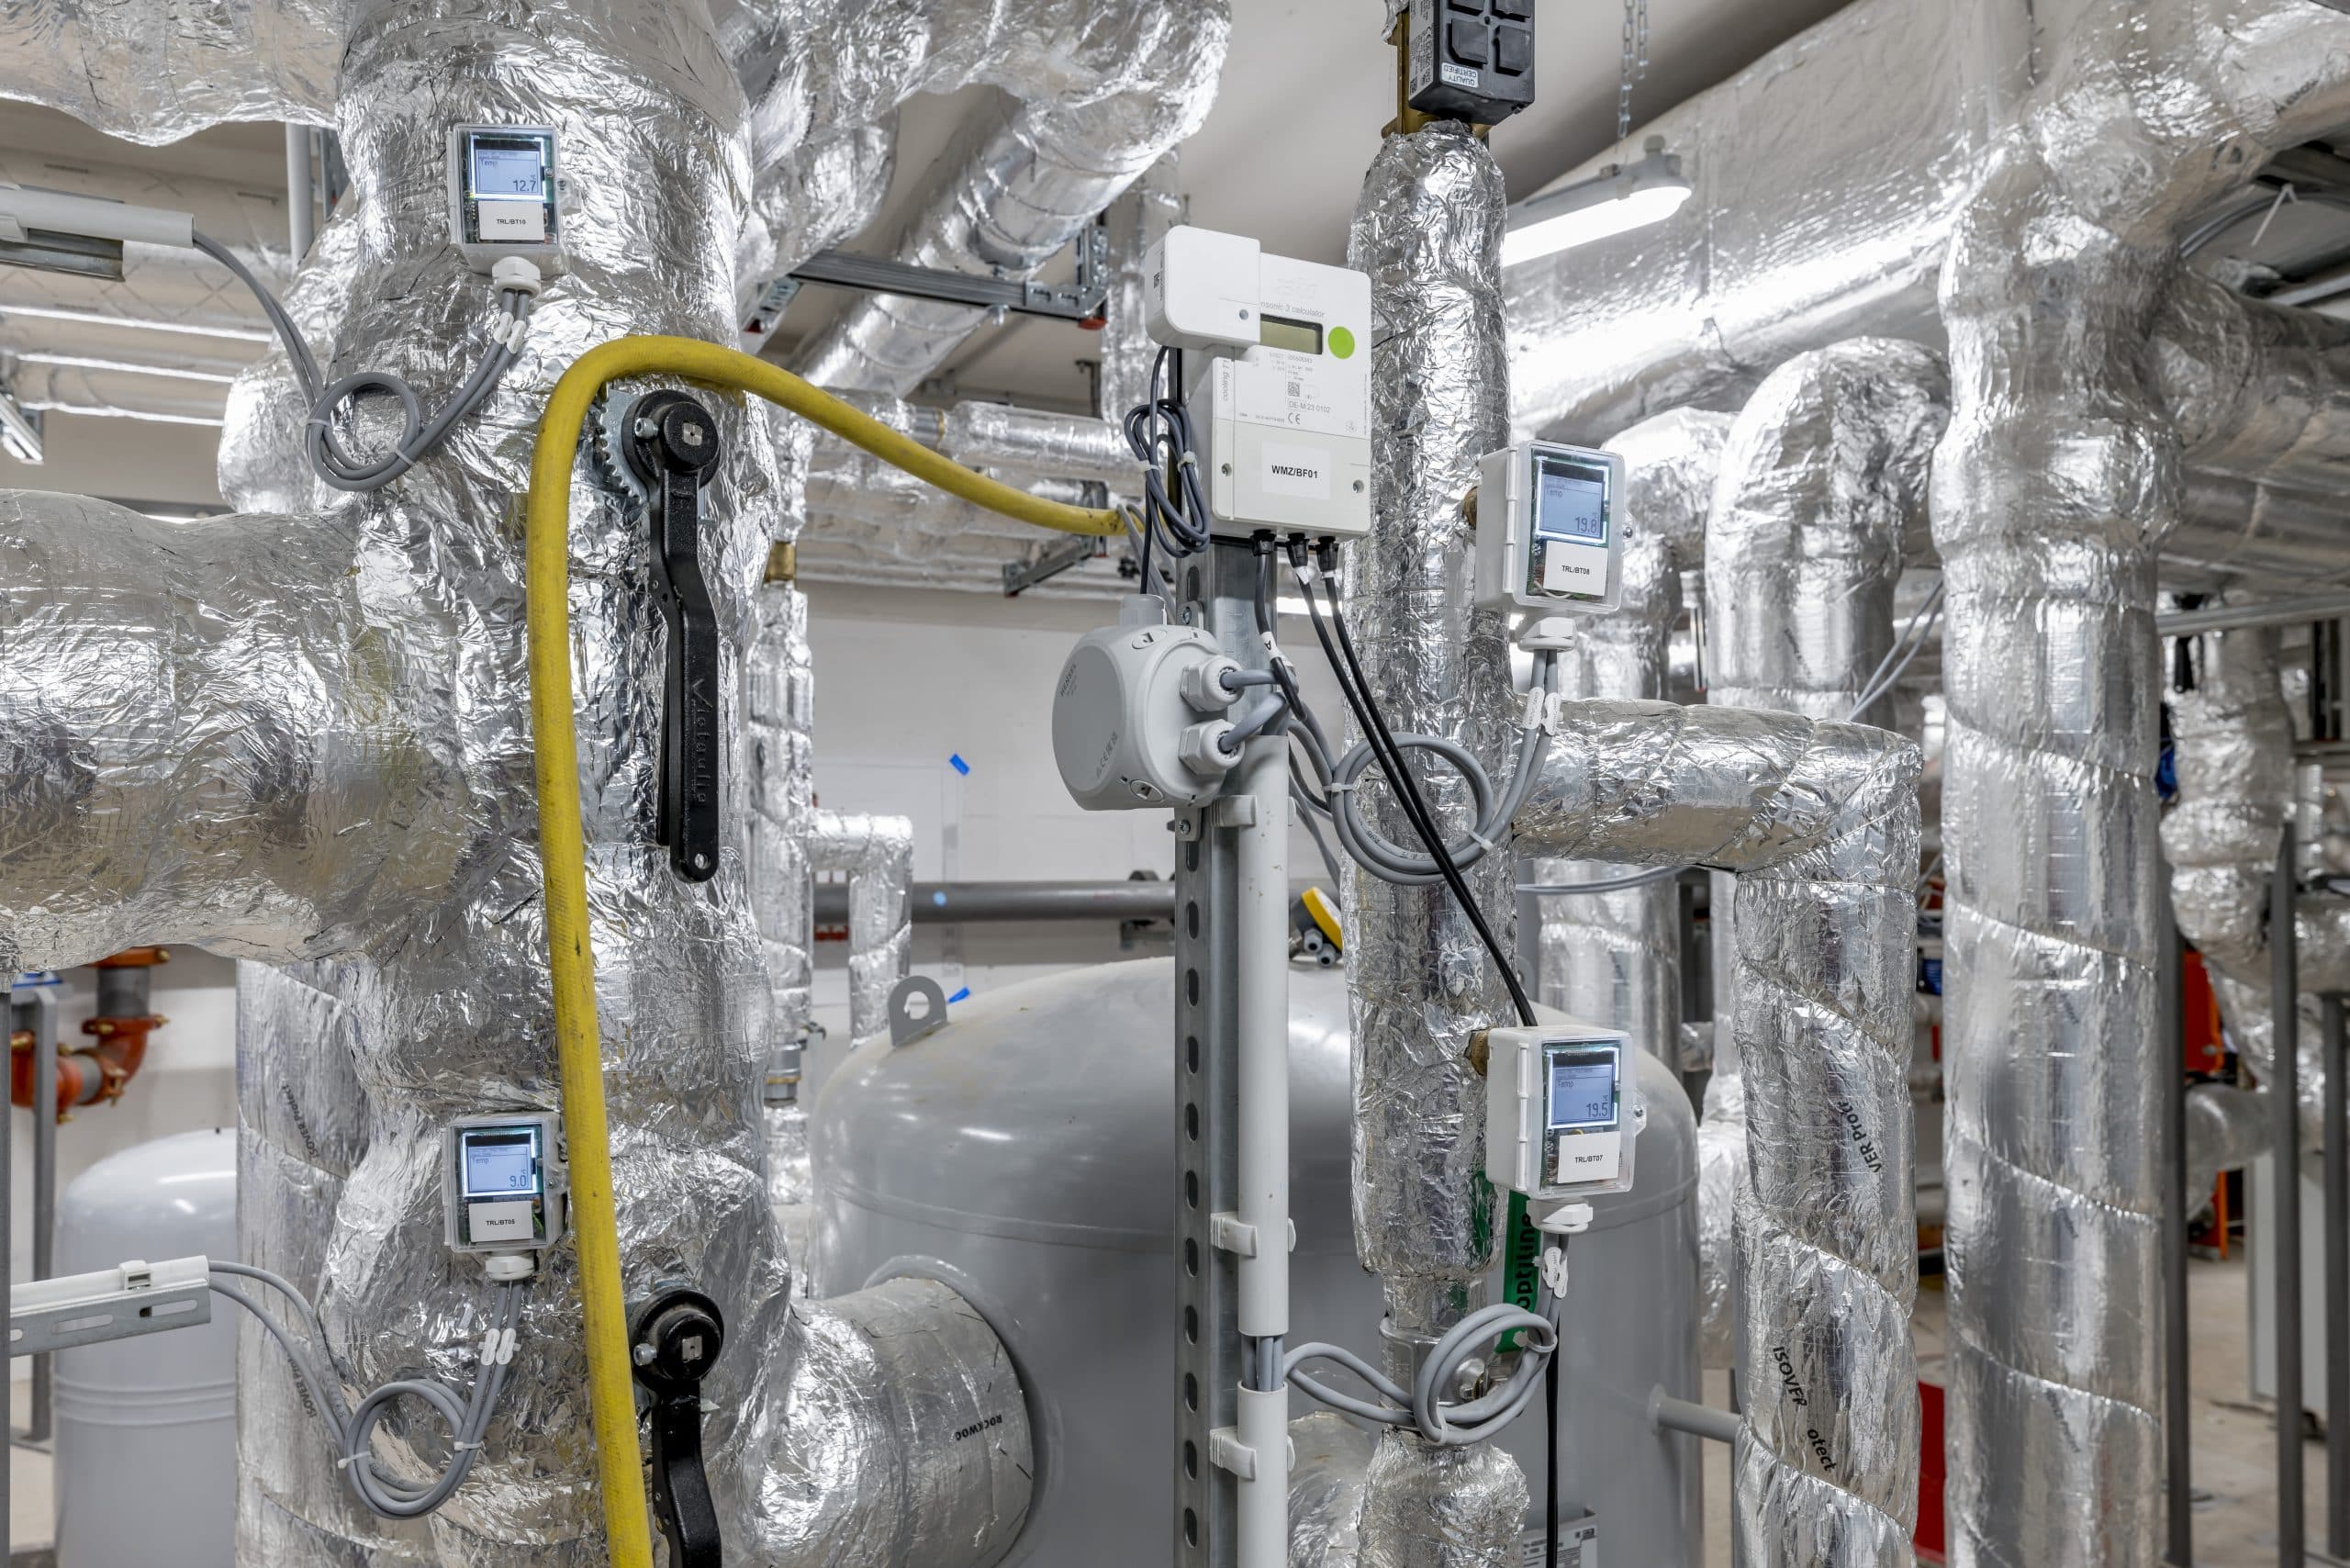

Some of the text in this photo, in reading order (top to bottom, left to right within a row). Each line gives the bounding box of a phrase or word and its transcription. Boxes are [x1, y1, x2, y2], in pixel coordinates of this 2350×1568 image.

[1443, 64, 1477, 78] CERTIFIED
[512, 179, 537, 192] 12.7
[1292, 306, 1325, 318] calculator
[1288, 412, 1301, 425] CE
[1271, 465, 1318, 479] WMZ/BF01
[1574, 516, 1597, 533] 19.8
[1561, 565, 1590, 575] TRL/BT08
[1557, 1080, 1574, 1088] Temp
[1585, 1102, 1608, 1117] 19.5
[1574, 1154, 1604, 1163] TRL/BT07
[509, 1174, 527, 1188] 9.0
[485, 1218, 516, 1226] TRL/BT05
[296, 1380, 318, 1418] ISOVER
[1807, 1428, 1837, 1472] otect
